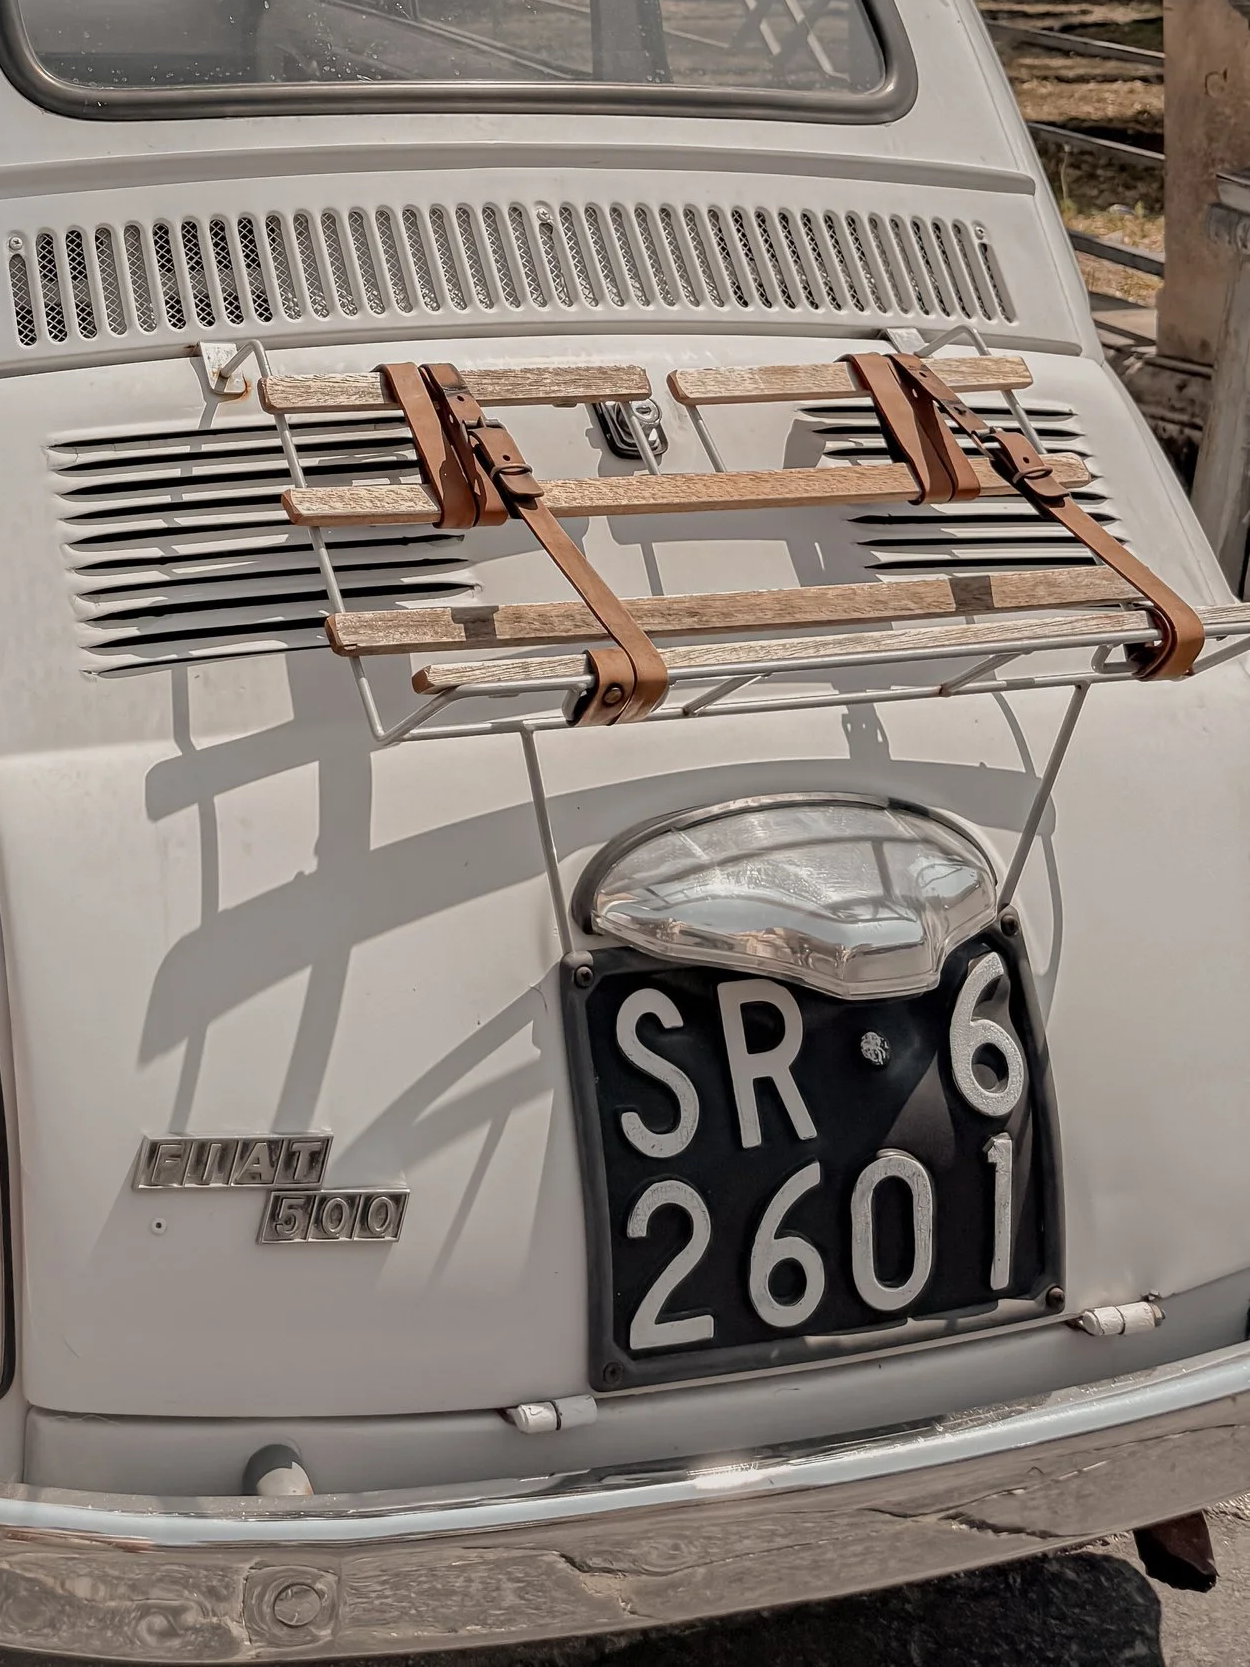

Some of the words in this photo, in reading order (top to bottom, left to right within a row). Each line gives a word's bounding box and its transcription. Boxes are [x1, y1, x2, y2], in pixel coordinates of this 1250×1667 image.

[616, 979, 818, 1158] SR
[950, 951, 1024, 1117] 6
[150, 1141, 323, 1184] FIAT
[274, 1195, 396, 1234] 500
[626, 1133, 1013, 1351] 2601
